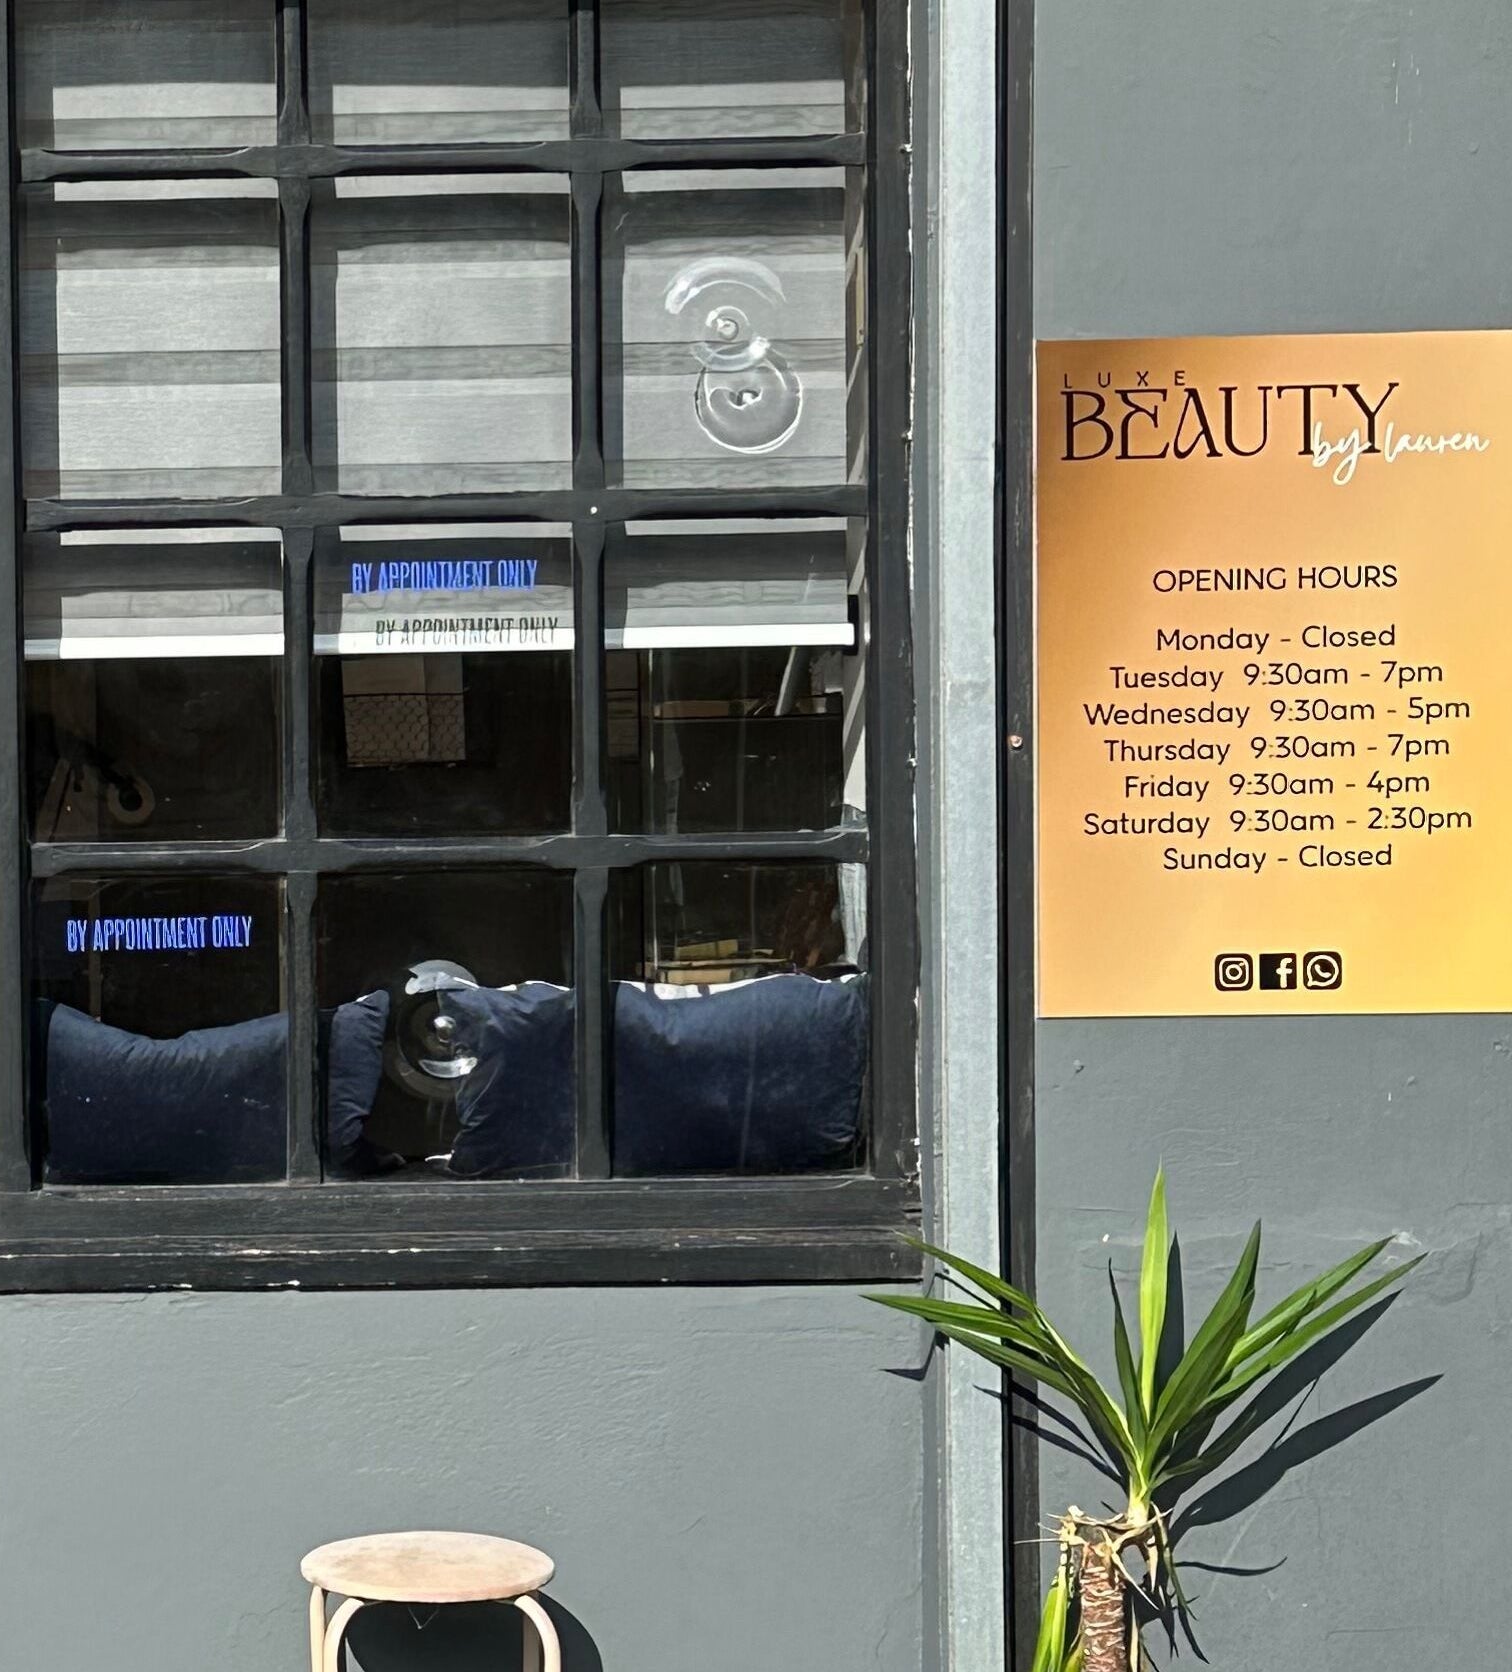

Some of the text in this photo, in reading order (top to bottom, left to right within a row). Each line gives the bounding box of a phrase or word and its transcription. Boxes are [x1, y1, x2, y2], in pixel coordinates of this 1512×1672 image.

[1063, 370, 1186, 389] LUXE
[1059, 382, 1400, 462] BEAUTY
[1311, 421, 1491, 486] by lauren
[351, 559, 538, 595] BY APPOINTMENT ONLY
[1153, 565, 1398, 593] OPENING HOURS
[1157, 627, 1270, 655] Monday
[1301, 624, 1396, 648] Closed
[1109, 665, 1225, 691] Tuesday
[1243, 662, 1349, 687] 9:30am
[1381, 660, 1444, 688] 7pm
[1083, 701, 1251, 728] Wednesday
[1269, 699, 1376, 723] 9:30am
[1407, 697, 1471, 725] 5pm
[1104, 738, 1231, 765] Thursday
[1250, 735, 1356, 760] 9:30am
[1387, 733, 1450, 763] 7pm
[1124, 774, 1210, 803] Friday
[1228, 772, 1334, 796] 9:30am
[1366, 770, 1430, 799] 4pm
[1083, 811, 1211, 838] Saturday
[1229, 809, 1335, 834] 9:30am
[1367, 806, 1472, 835] 2:30pm
[1162, 846, 1267, 872] Sunday
[1298, 843, 1393, 868] Closed
[66, 915, 253, 952] BY APPOINTMENT ONLY
